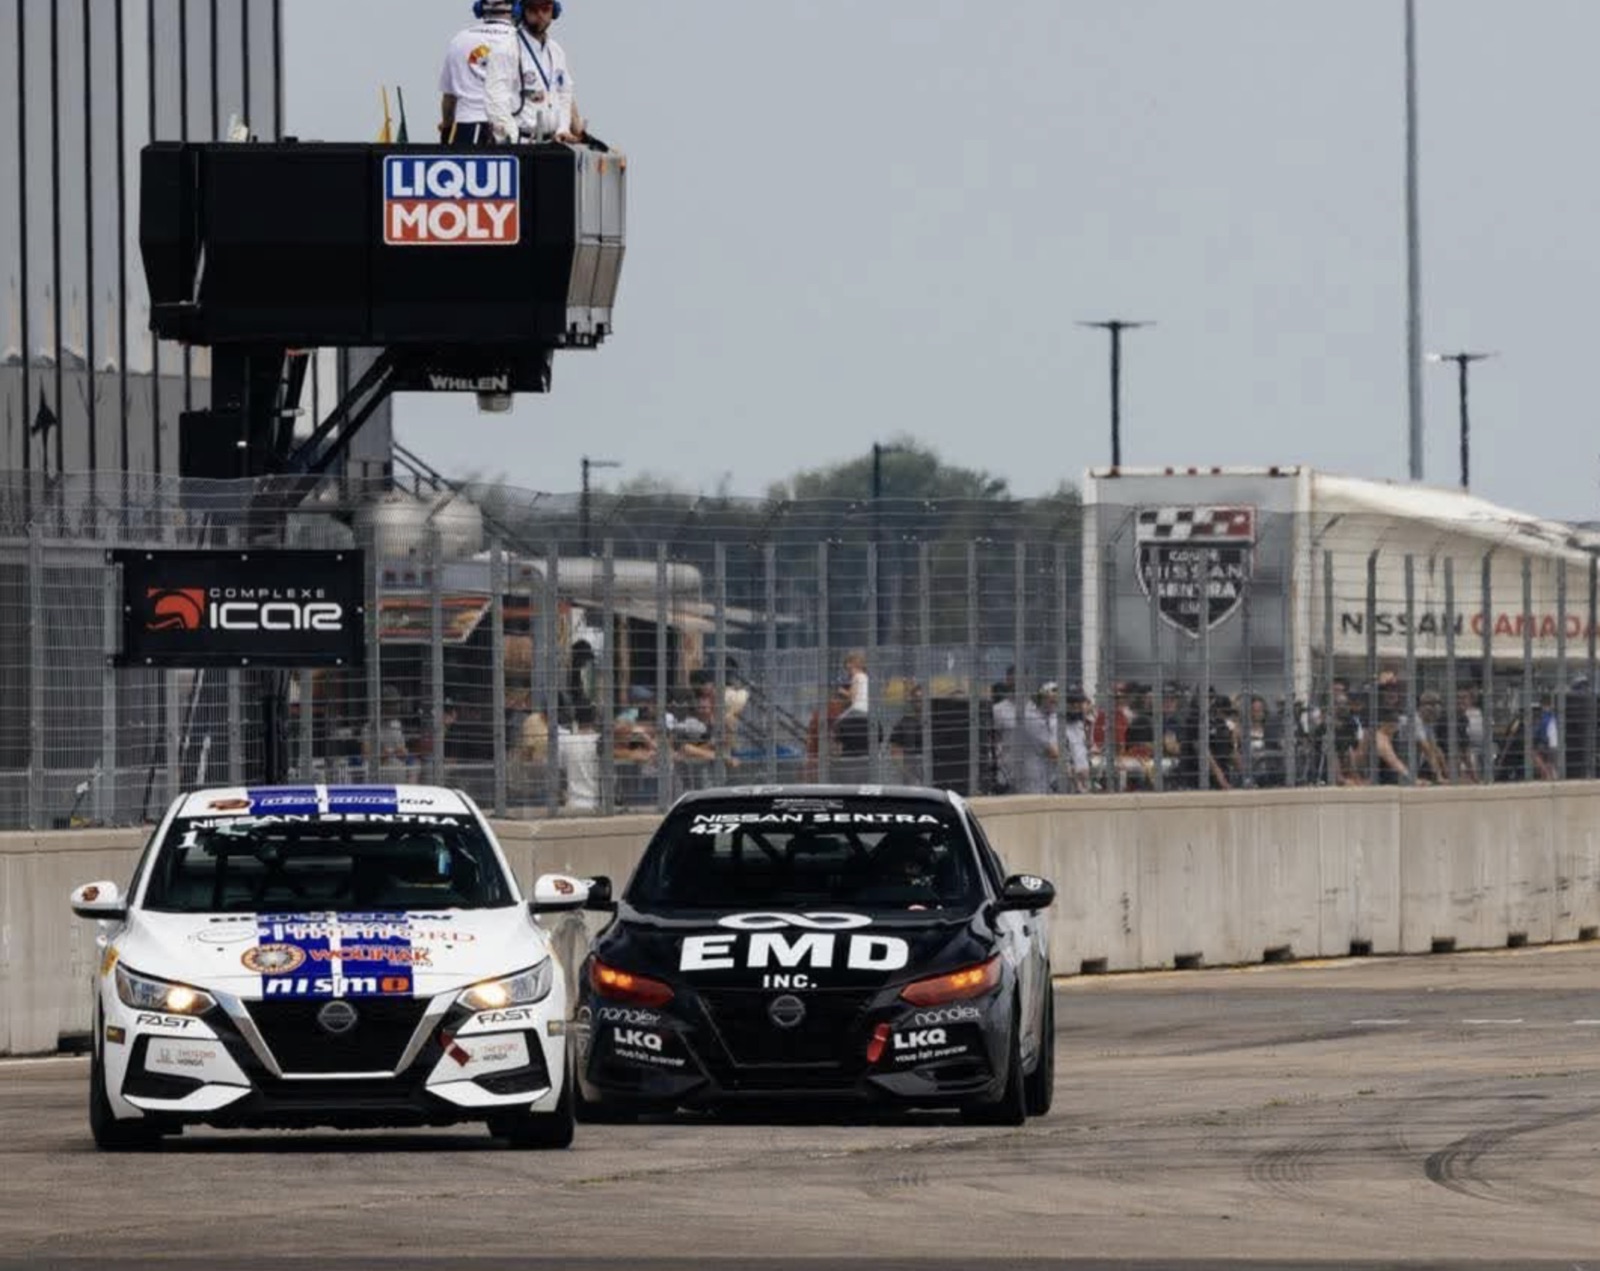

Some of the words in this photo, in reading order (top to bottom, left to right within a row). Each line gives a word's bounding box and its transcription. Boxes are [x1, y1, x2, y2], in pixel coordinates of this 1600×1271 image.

[392, 160, 511, 198] LIQUI
[392, 202, 515, 240] MOLY
[429, 374, 507, 390] WHELEN
[209, 588, 326, 598] COMPLEXE
[209, 602, 343, 630] ICAR
[319, 813, 460, 826] SENTRA
[693, 813, 803, 823] NISSAN
[813, 813, 940, 824] SENTRA
[689, 823, 741, 834] 427
[679, 932, 909, 971] EMD
[763, 974, 818, 988] INC.
[136, 1013, 195, 1028] FAST
[477, 1008, 533, 1024] FAST
[915, 1005, 981, 1026] nanolex
[613, 1026, 662, 1051] LKQ
[893, 1028, 947, 1049] LKQ
